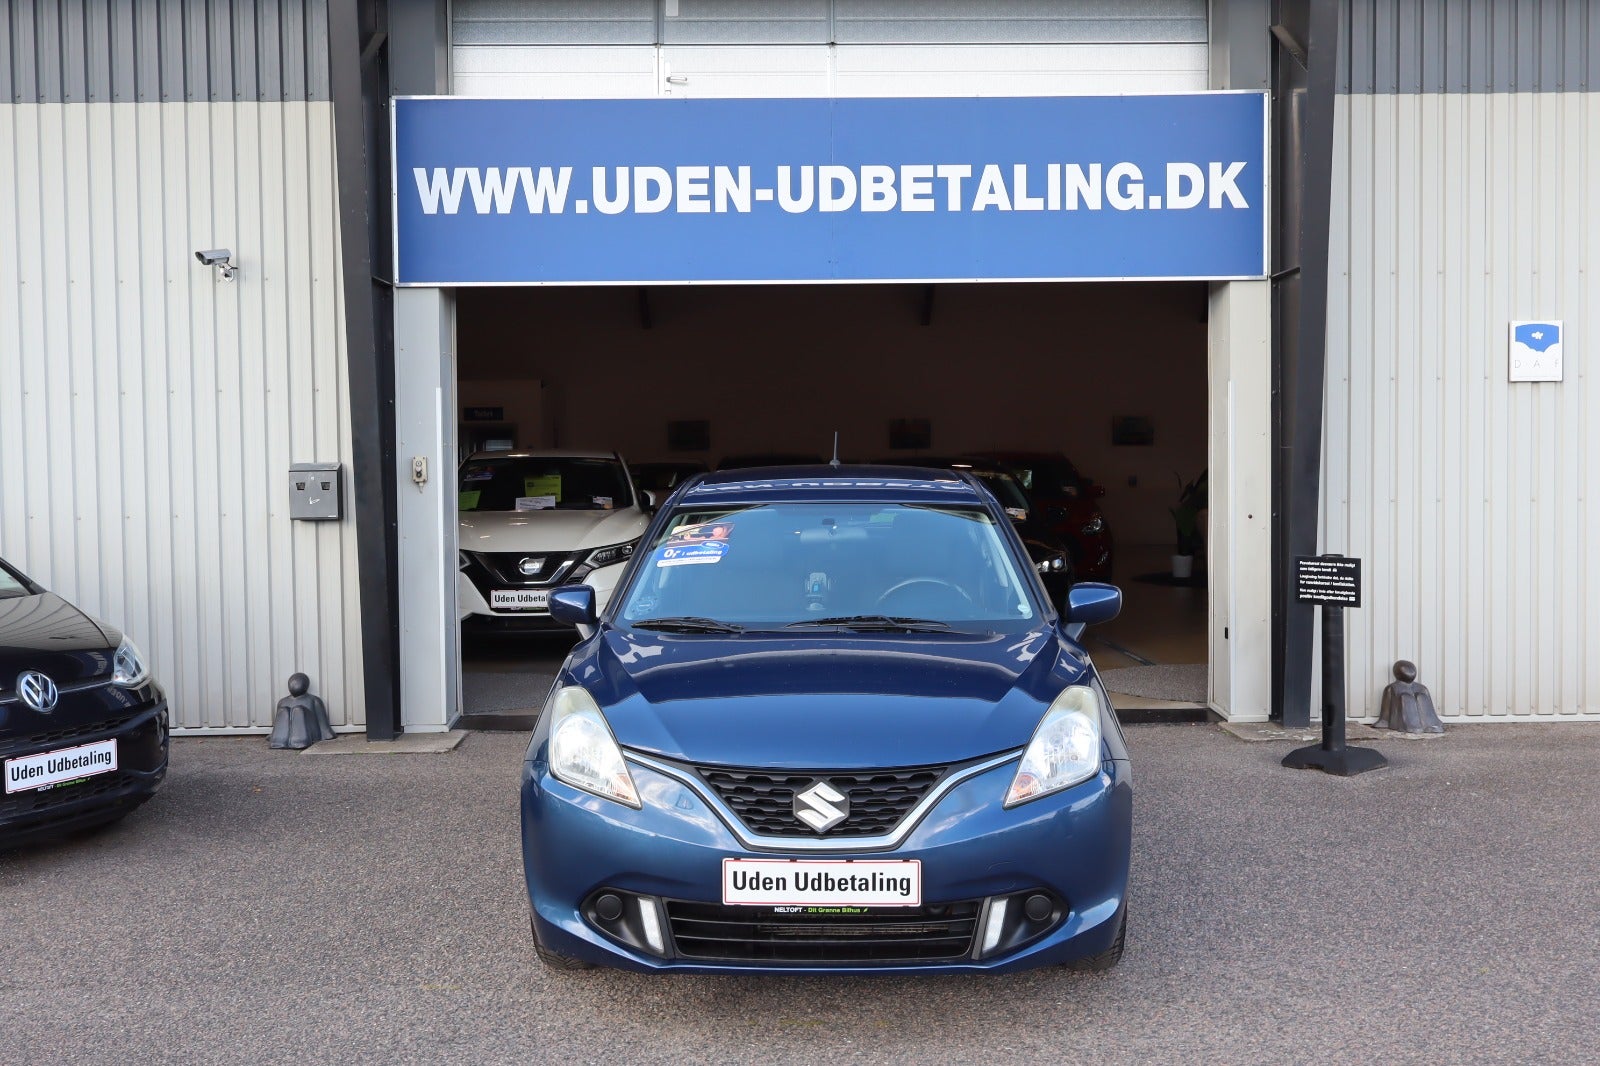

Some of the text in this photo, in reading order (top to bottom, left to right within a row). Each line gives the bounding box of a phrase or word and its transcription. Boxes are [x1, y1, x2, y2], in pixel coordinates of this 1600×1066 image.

[413, 161, 1249, 215] WWW.UDEN-UDBETALING.DK
[494, 594, 515, 603] Uden
[11, 751, 112, 781] Uden Udbetaling
[732, 870, 911, 897] Uden Udbetaling
